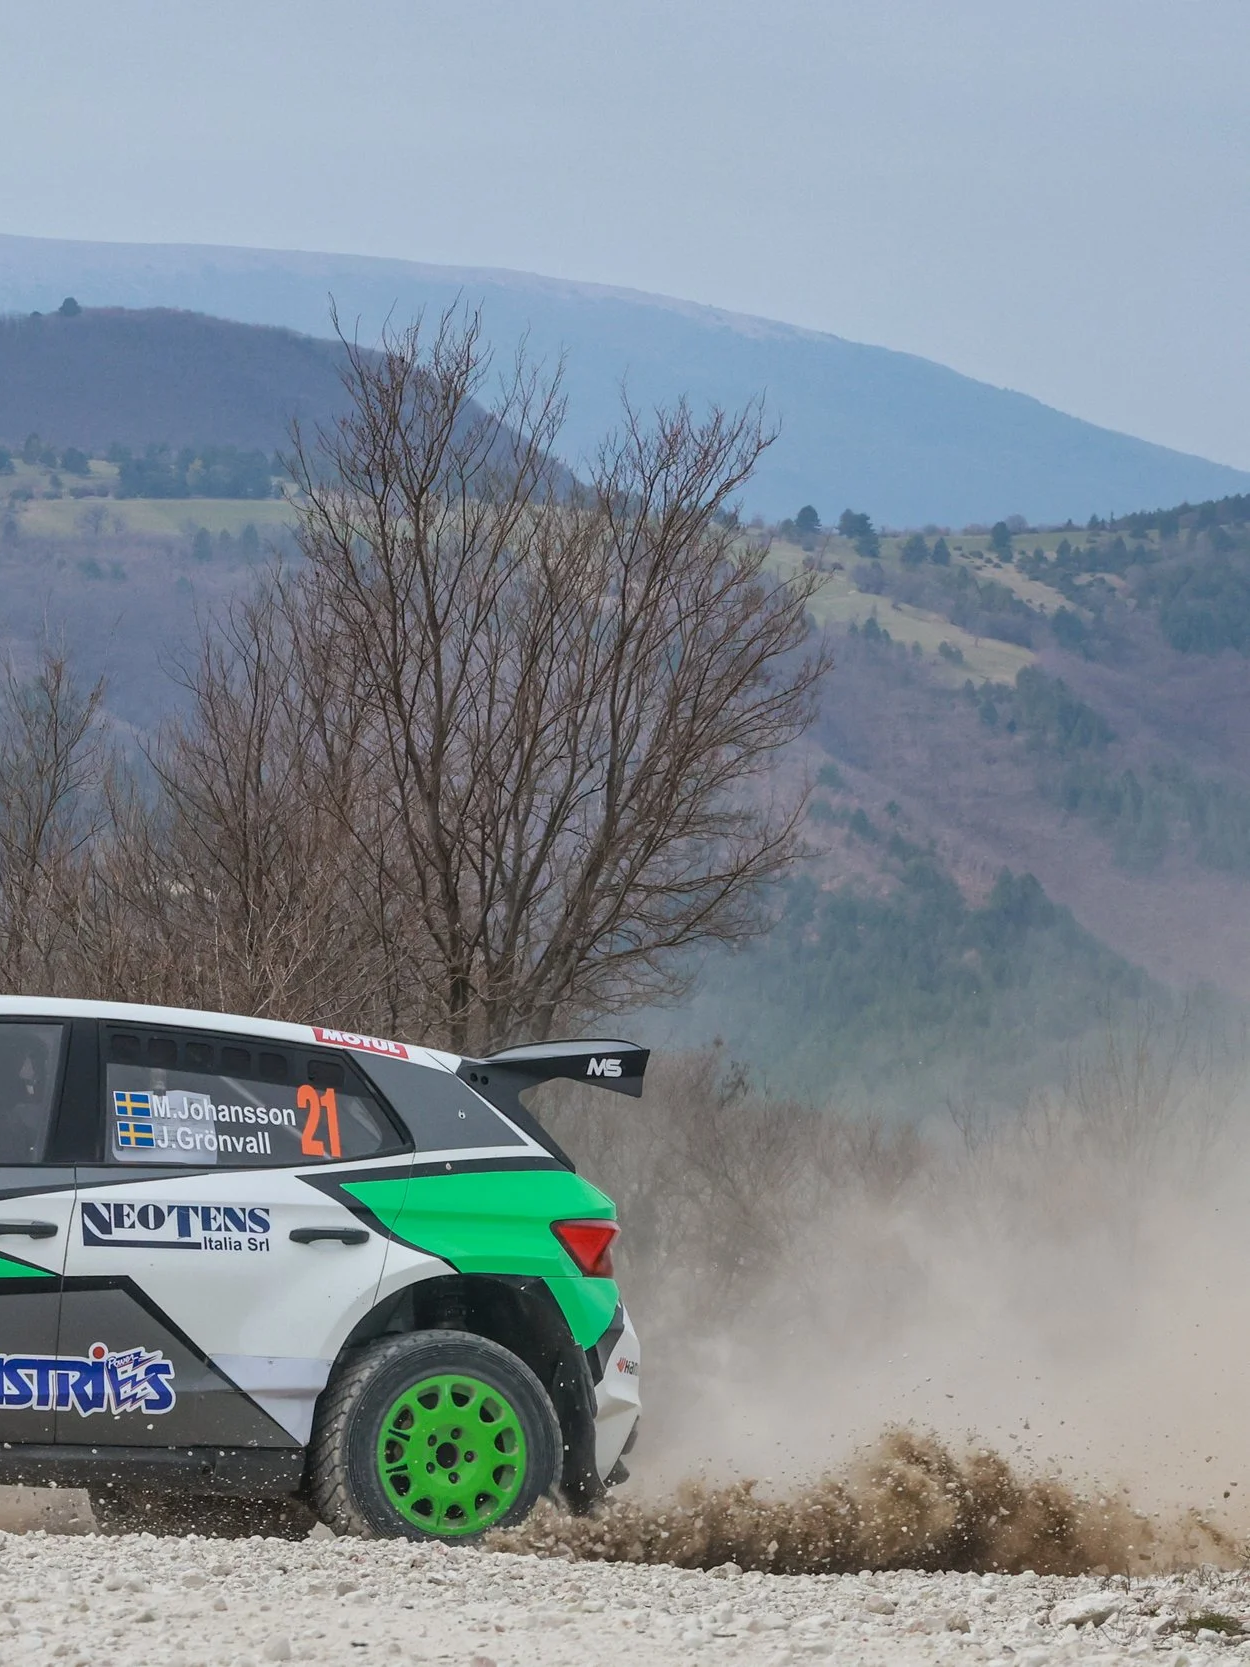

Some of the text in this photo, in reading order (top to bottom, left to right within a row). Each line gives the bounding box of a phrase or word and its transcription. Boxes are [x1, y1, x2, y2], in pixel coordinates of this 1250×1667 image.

[322, 1028, 401, 1054] MOTUL
[586, 1057, 623, 1078] MS
[152, 1094, 297, 1126] M.Johansson
[296, 1084, 341, 1158] 21
[156, 1124, 272, 1155] J.Grönvall
[81, 1202, 270, 1240] NEOTENS
[203, 1236, 270, 1251] Italia Srl
